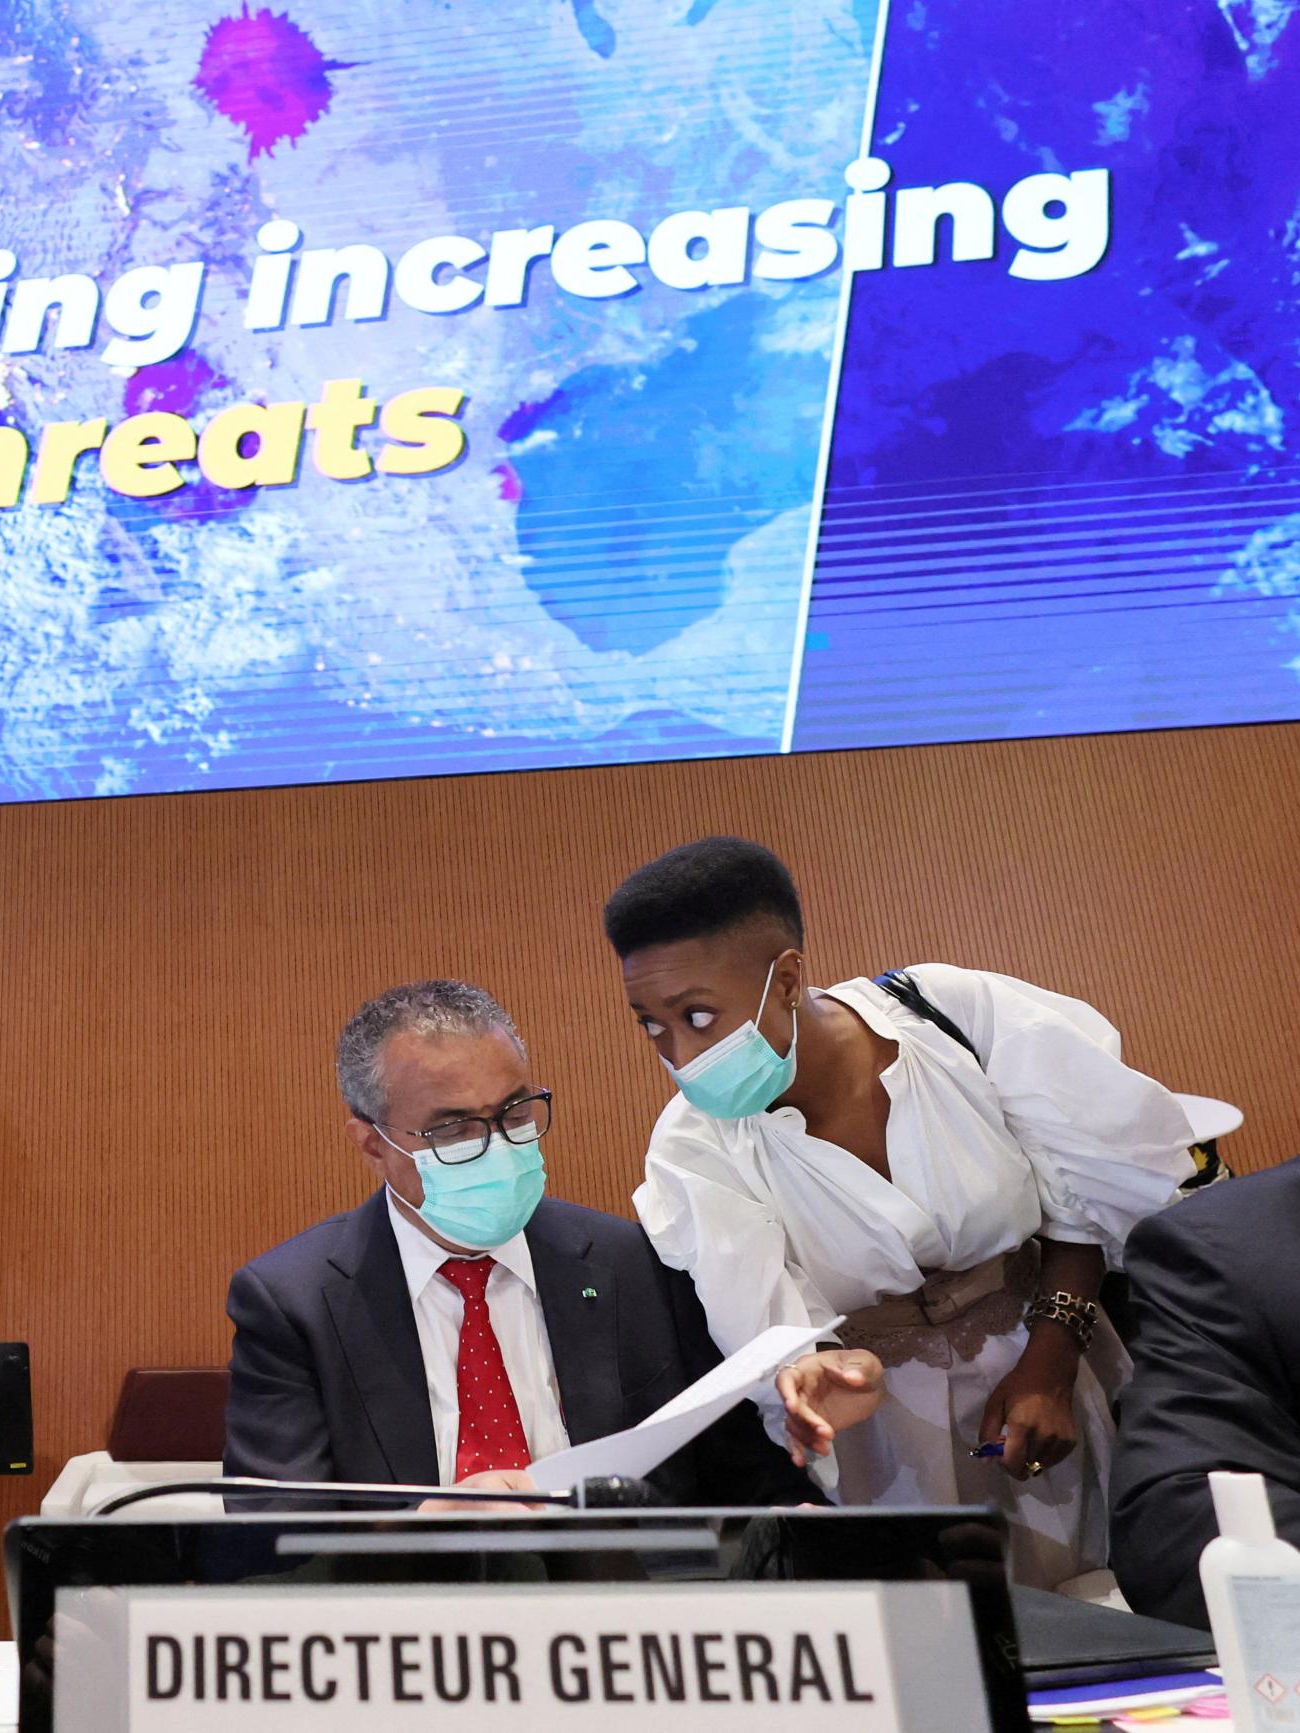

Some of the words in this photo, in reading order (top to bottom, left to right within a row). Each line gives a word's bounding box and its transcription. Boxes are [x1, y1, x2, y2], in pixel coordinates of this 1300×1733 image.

[242, 156, 1110, 333] increasing
[146, 1633, 522, 1704] DIRECTEUR
[549, 1633, 875, 1704] GENERAL
